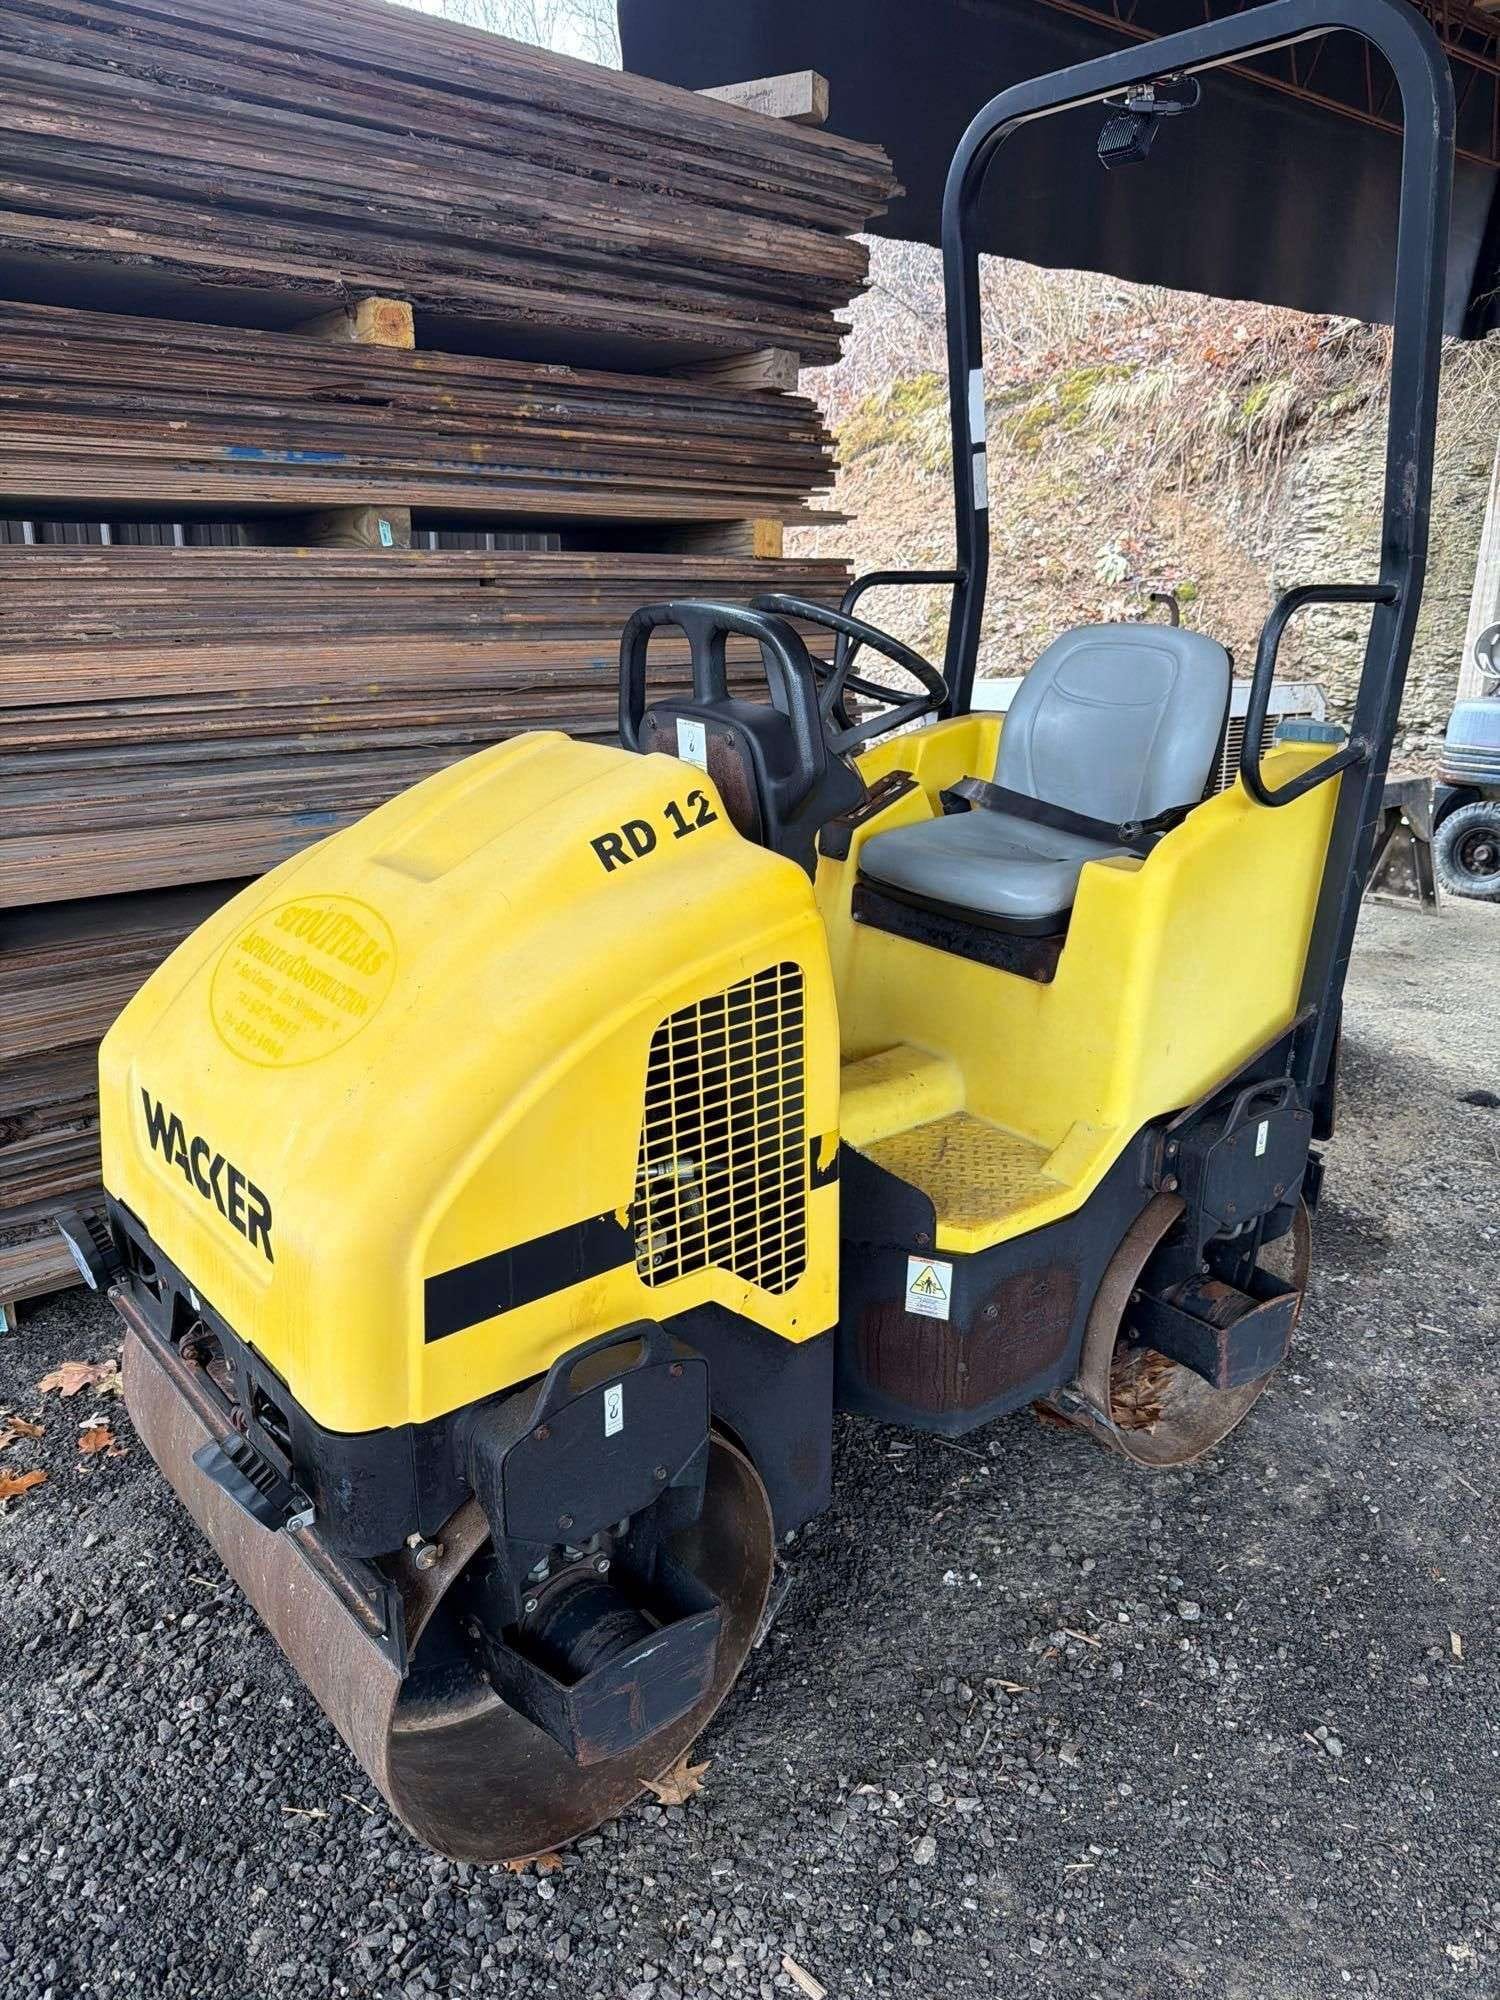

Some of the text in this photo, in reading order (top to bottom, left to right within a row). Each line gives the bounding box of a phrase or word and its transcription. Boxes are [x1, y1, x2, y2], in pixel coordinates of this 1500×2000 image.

[590, 789, 719, 873] RD 12
[141, 1086, 275, 1265] WACKER
